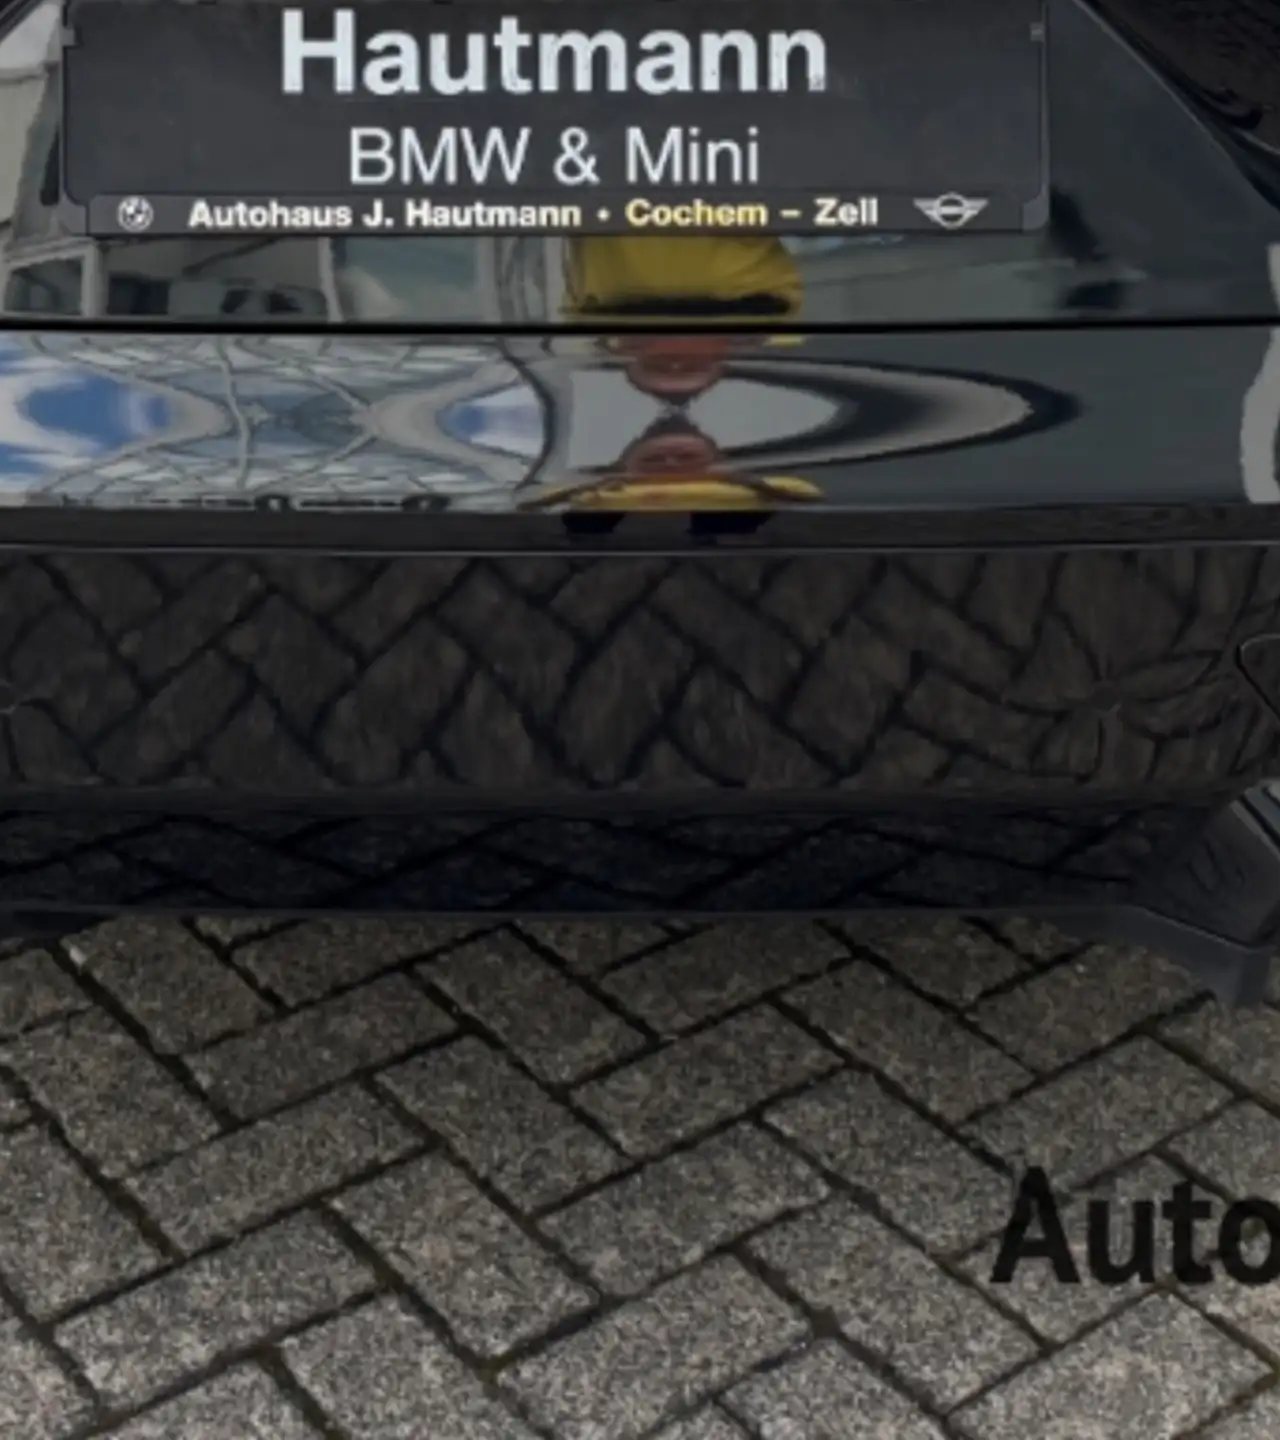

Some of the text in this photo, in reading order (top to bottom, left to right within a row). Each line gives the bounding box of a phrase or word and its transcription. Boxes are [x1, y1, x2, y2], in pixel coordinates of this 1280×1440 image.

[281, 8, 827, 95] Hautmann
[350, 126, 758, 185] BMW & Mini
[188, 198, 352, 228] Autohaus
[362, 198, 394, 228] J.
[405, 198, 582, 228] Hautmann
[625, 197, 768, 227] Cochem
[813, 197, 878, 227] Zell
